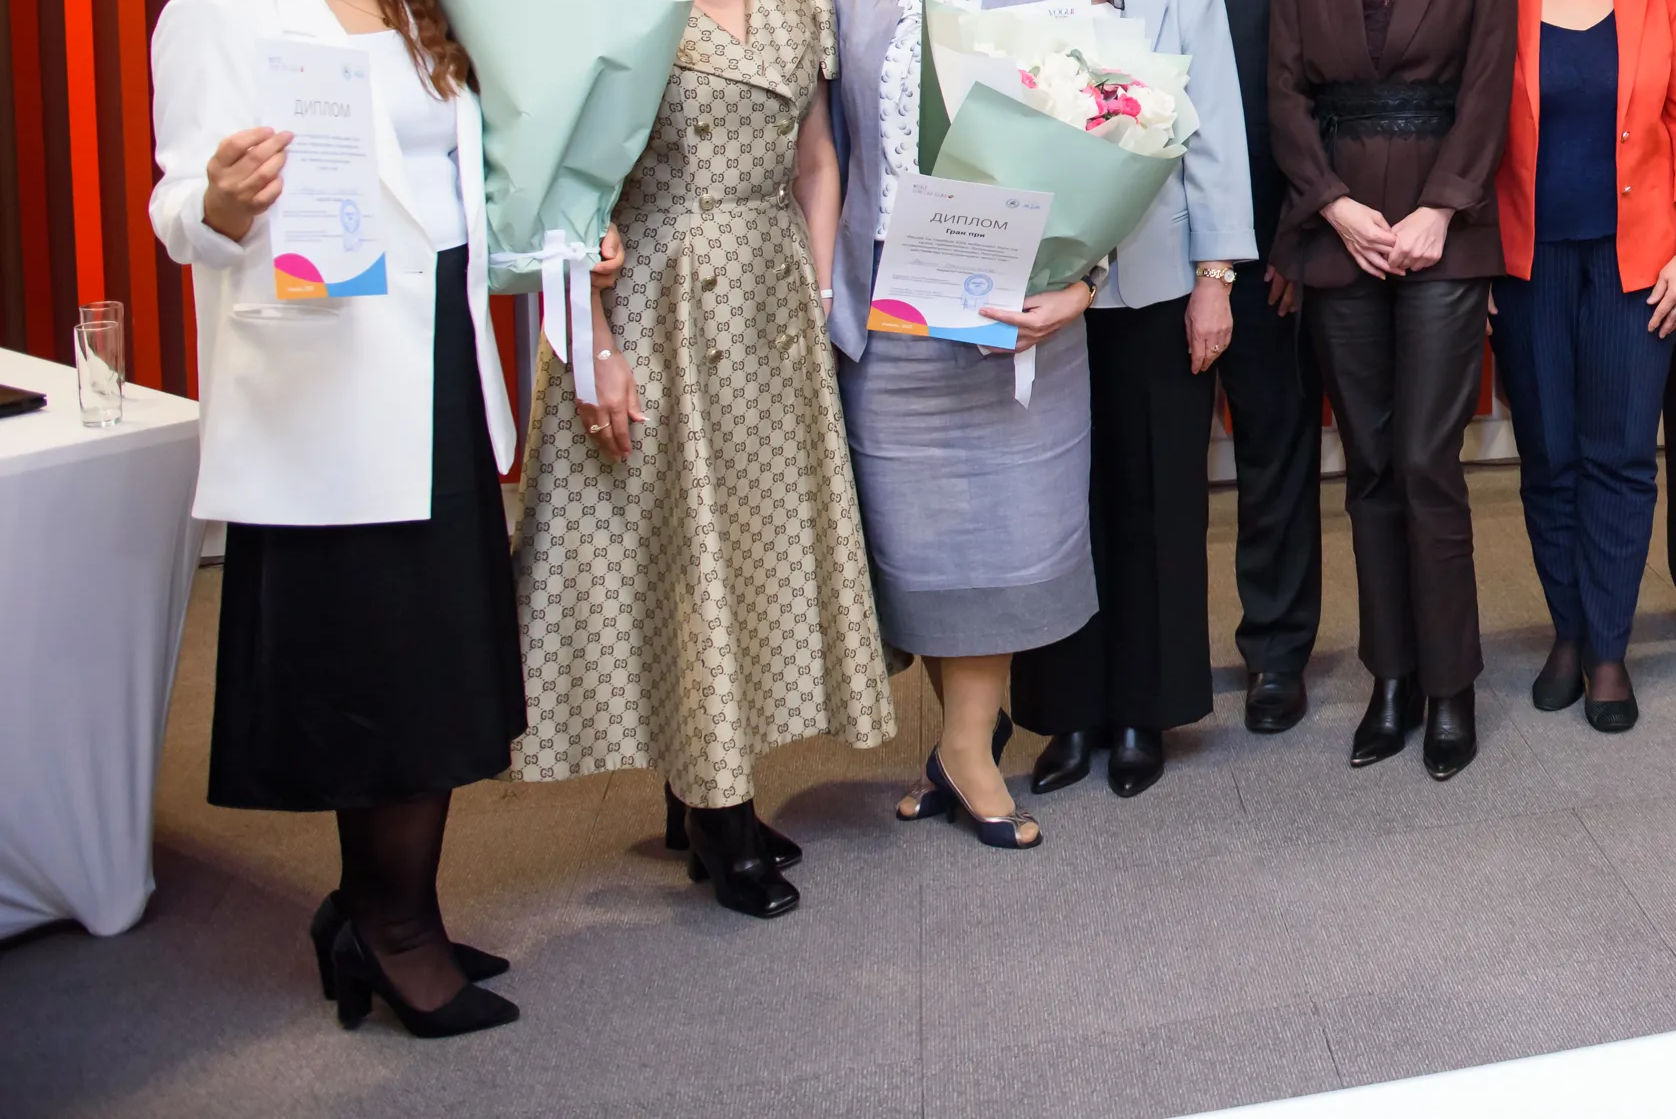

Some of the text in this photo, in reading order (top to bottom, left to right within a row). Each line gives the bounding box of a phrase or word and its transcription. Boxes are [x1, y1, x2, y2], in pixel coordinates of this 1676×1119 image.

[293, 98, 352, 118] ДИПЛОМ
[929, 212, 1009, 231] ДИПЛОМ
[945, 228, 986, 239] Гран при
